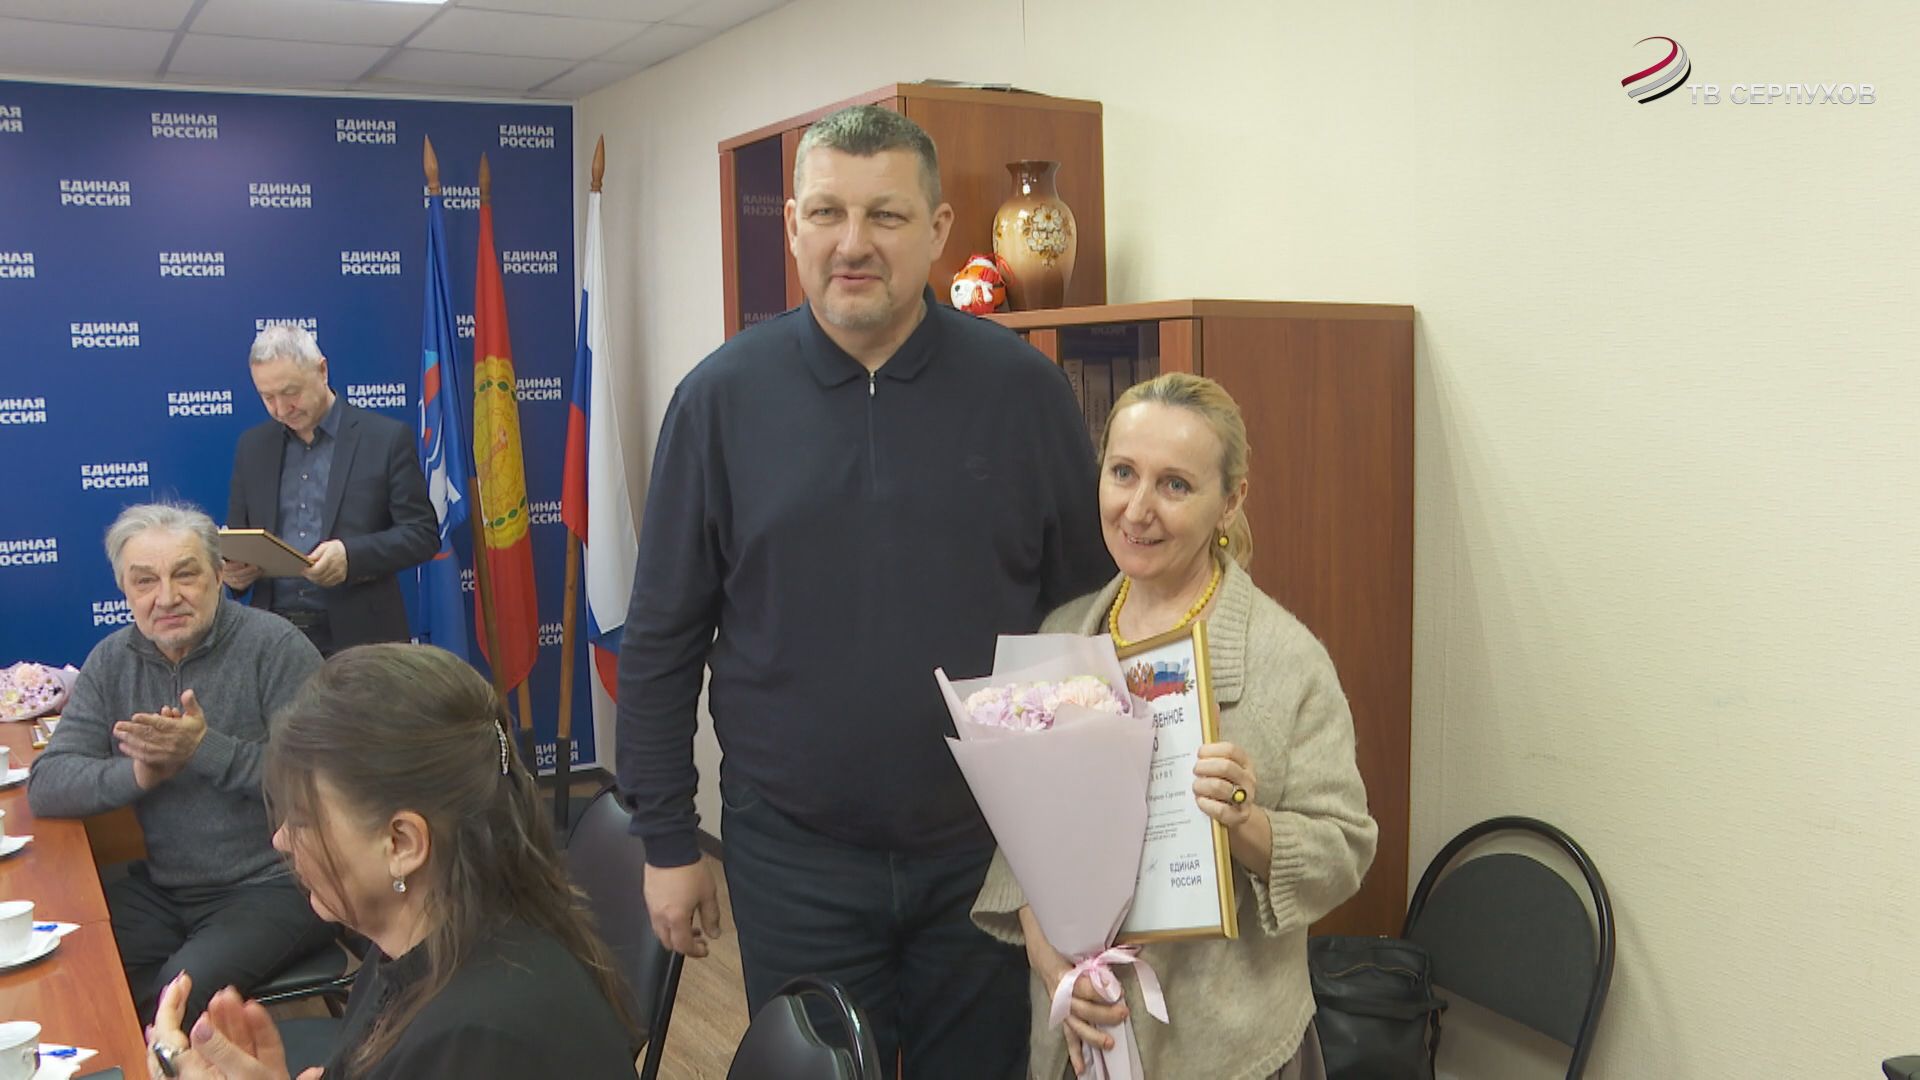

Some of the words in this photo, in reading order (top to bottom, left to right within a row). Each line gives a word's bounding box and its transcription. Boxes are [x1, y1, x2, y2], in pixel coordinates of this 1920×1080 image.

[152, 112, 218, 127] ЕДИНАЯ
[337, 118, 396, 132] ЕДИНАЯ
[152, 125, 219, 140] РОССИЯ
[500, 124, 554, 137] ЕДИНАЯ
[337, 131, 396, 145] РОССИЯ
[500, 136, 555, 149] РОССИЯ
[60, 180, 130, 194] ЕДИНАЯ
[249, 183, 311, 197] ЕДИНАЯ
[424, 186, 480, 197] ЕИНАЯ
[61, 193, 131, 207] РОССИЯ
[250, 196, 312, 209] РОССИЯ
[424, 197, 480, 210] РССИЯ
[0, 252, 34, 265] НАЯ
[160, 252, 224, 265] ЕДИНАЯ
[341, 251, 400, 264] ЕДИНАЯ
[503, 251, 557, 264] ЕДИНАЯ
[0, 264, 36, 279] СИЯ
[160, 264, 225, 277] РОССИЯ
[341, 262, 401, 275] РОССИЯ
[503, 262, 558, 275] РОССИЯ
[70, 321, 139, 336] ЕДИНАЯ
[71, 335, 140, 349] РОССИЯ
[347, 383, 406, 397] ЕДИНАЯ
[516, 376, 561, 390] ДИНАЯ
[168, 390, 232, 404] ЕДИНАЯ
[516, 388, 561, 401] ОССИЯ
[0, 397, 46, 411] ИНАЯ
[169, 402, 233, 417] РОССИЯ
[0, 410, 47, 425] ССИЯ
[81, 461, 148, 477] ЕДИНАЯ
[82, 475, 149, 491] РОССИЯ
[529, 500, 562, 513] ИНА
[529, 512, 562, 525] ССИ
[0, 537, 57, 555] ДИНАЯ
[0, 550, 58, 567] ОССИЯ
[92, 600, 127, 614] ЕДИ
[93, 612, 136, 627] РОСС
[538, 623, 564, 635] ИНА
[538, 633, 564, 647] ССИ
[1169, 859, 1200, 873] ЕДИНАЯ
[1170, 874, 1202, 888] РОССИЯ
